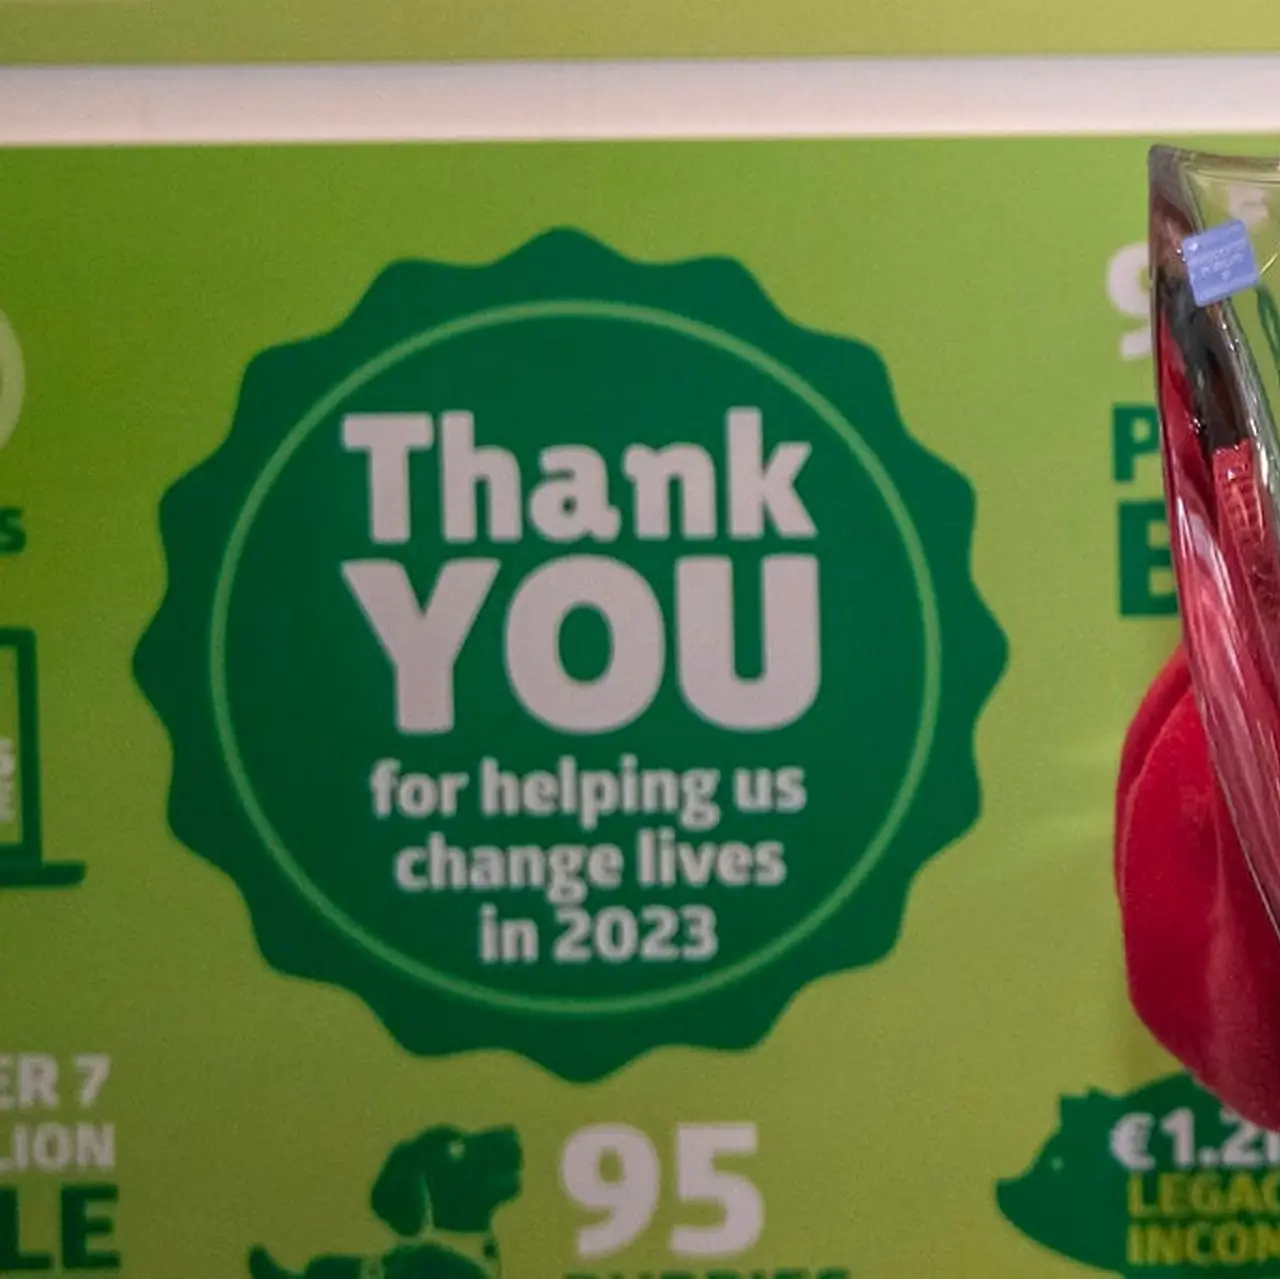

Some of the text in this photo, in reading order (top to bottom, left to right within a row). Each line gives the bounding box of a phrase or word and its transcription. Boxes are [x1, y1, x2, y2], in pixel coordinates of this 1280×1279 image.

[342, 407, 817, 543] Thank
[342, 554, 821, 734] YOU
[369, 753, 807, 832] for helping us
[394, 828, 787, 904] change lives
[480, 903, 719, 963] in 2023
[74, 1052, 111, 1108] 7
[560, 1122, 765, 1257] 95
